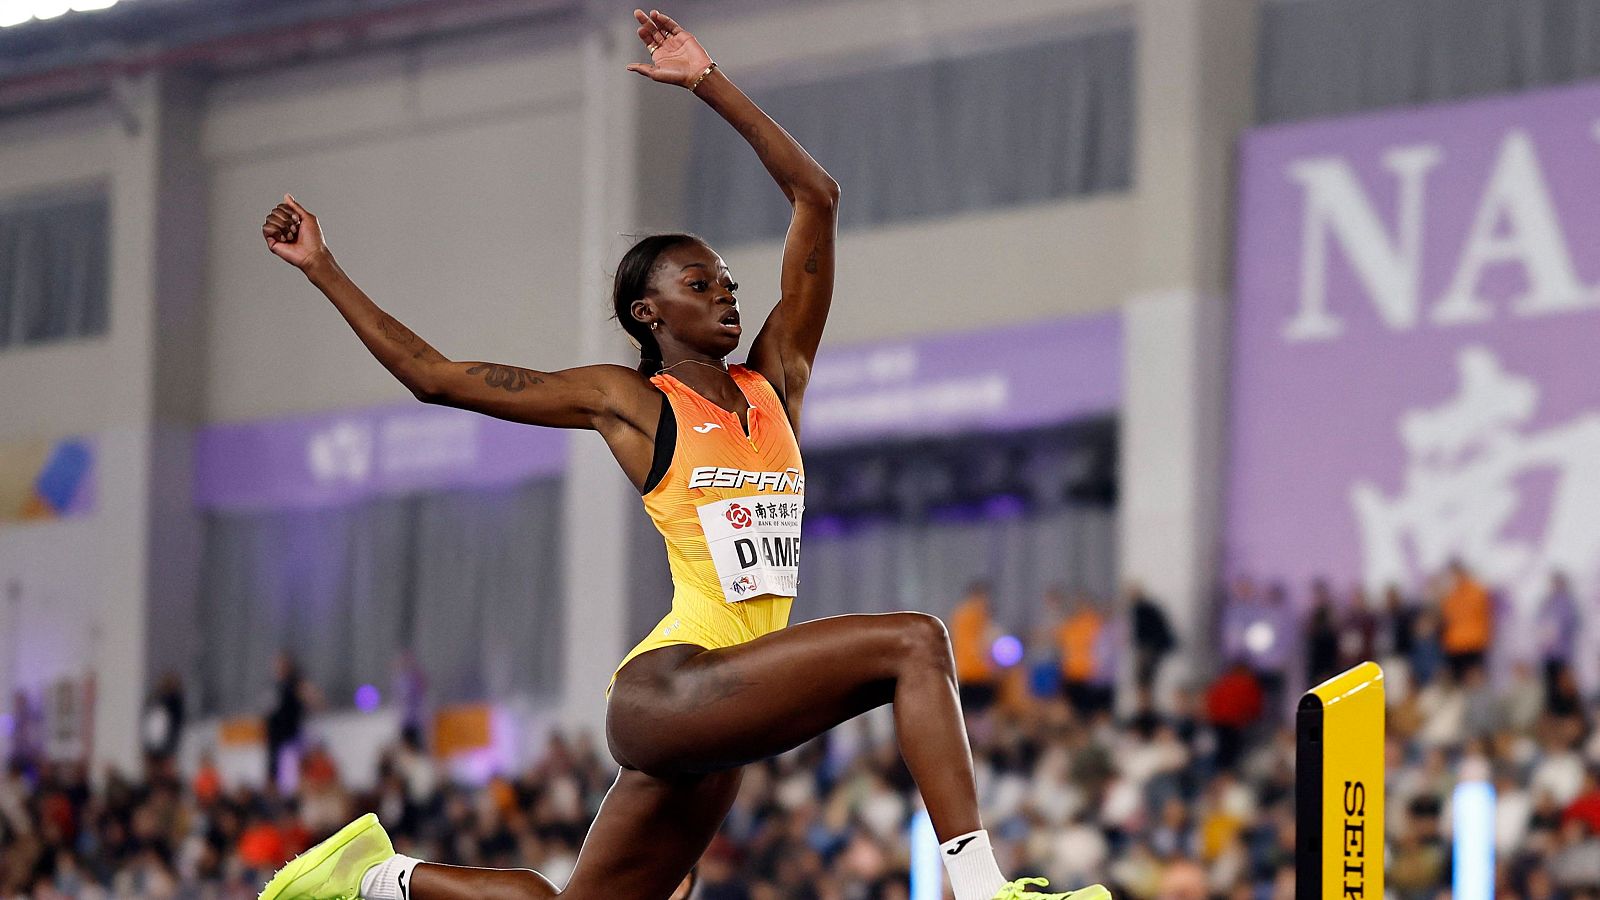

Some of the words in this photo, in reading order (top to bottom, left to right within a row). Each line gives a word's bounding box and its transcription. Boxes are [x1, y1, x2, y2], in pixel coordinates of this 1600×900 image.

[1284, 115, 1600, 340] NA
[755, 502, 798, 519] 南京银行
